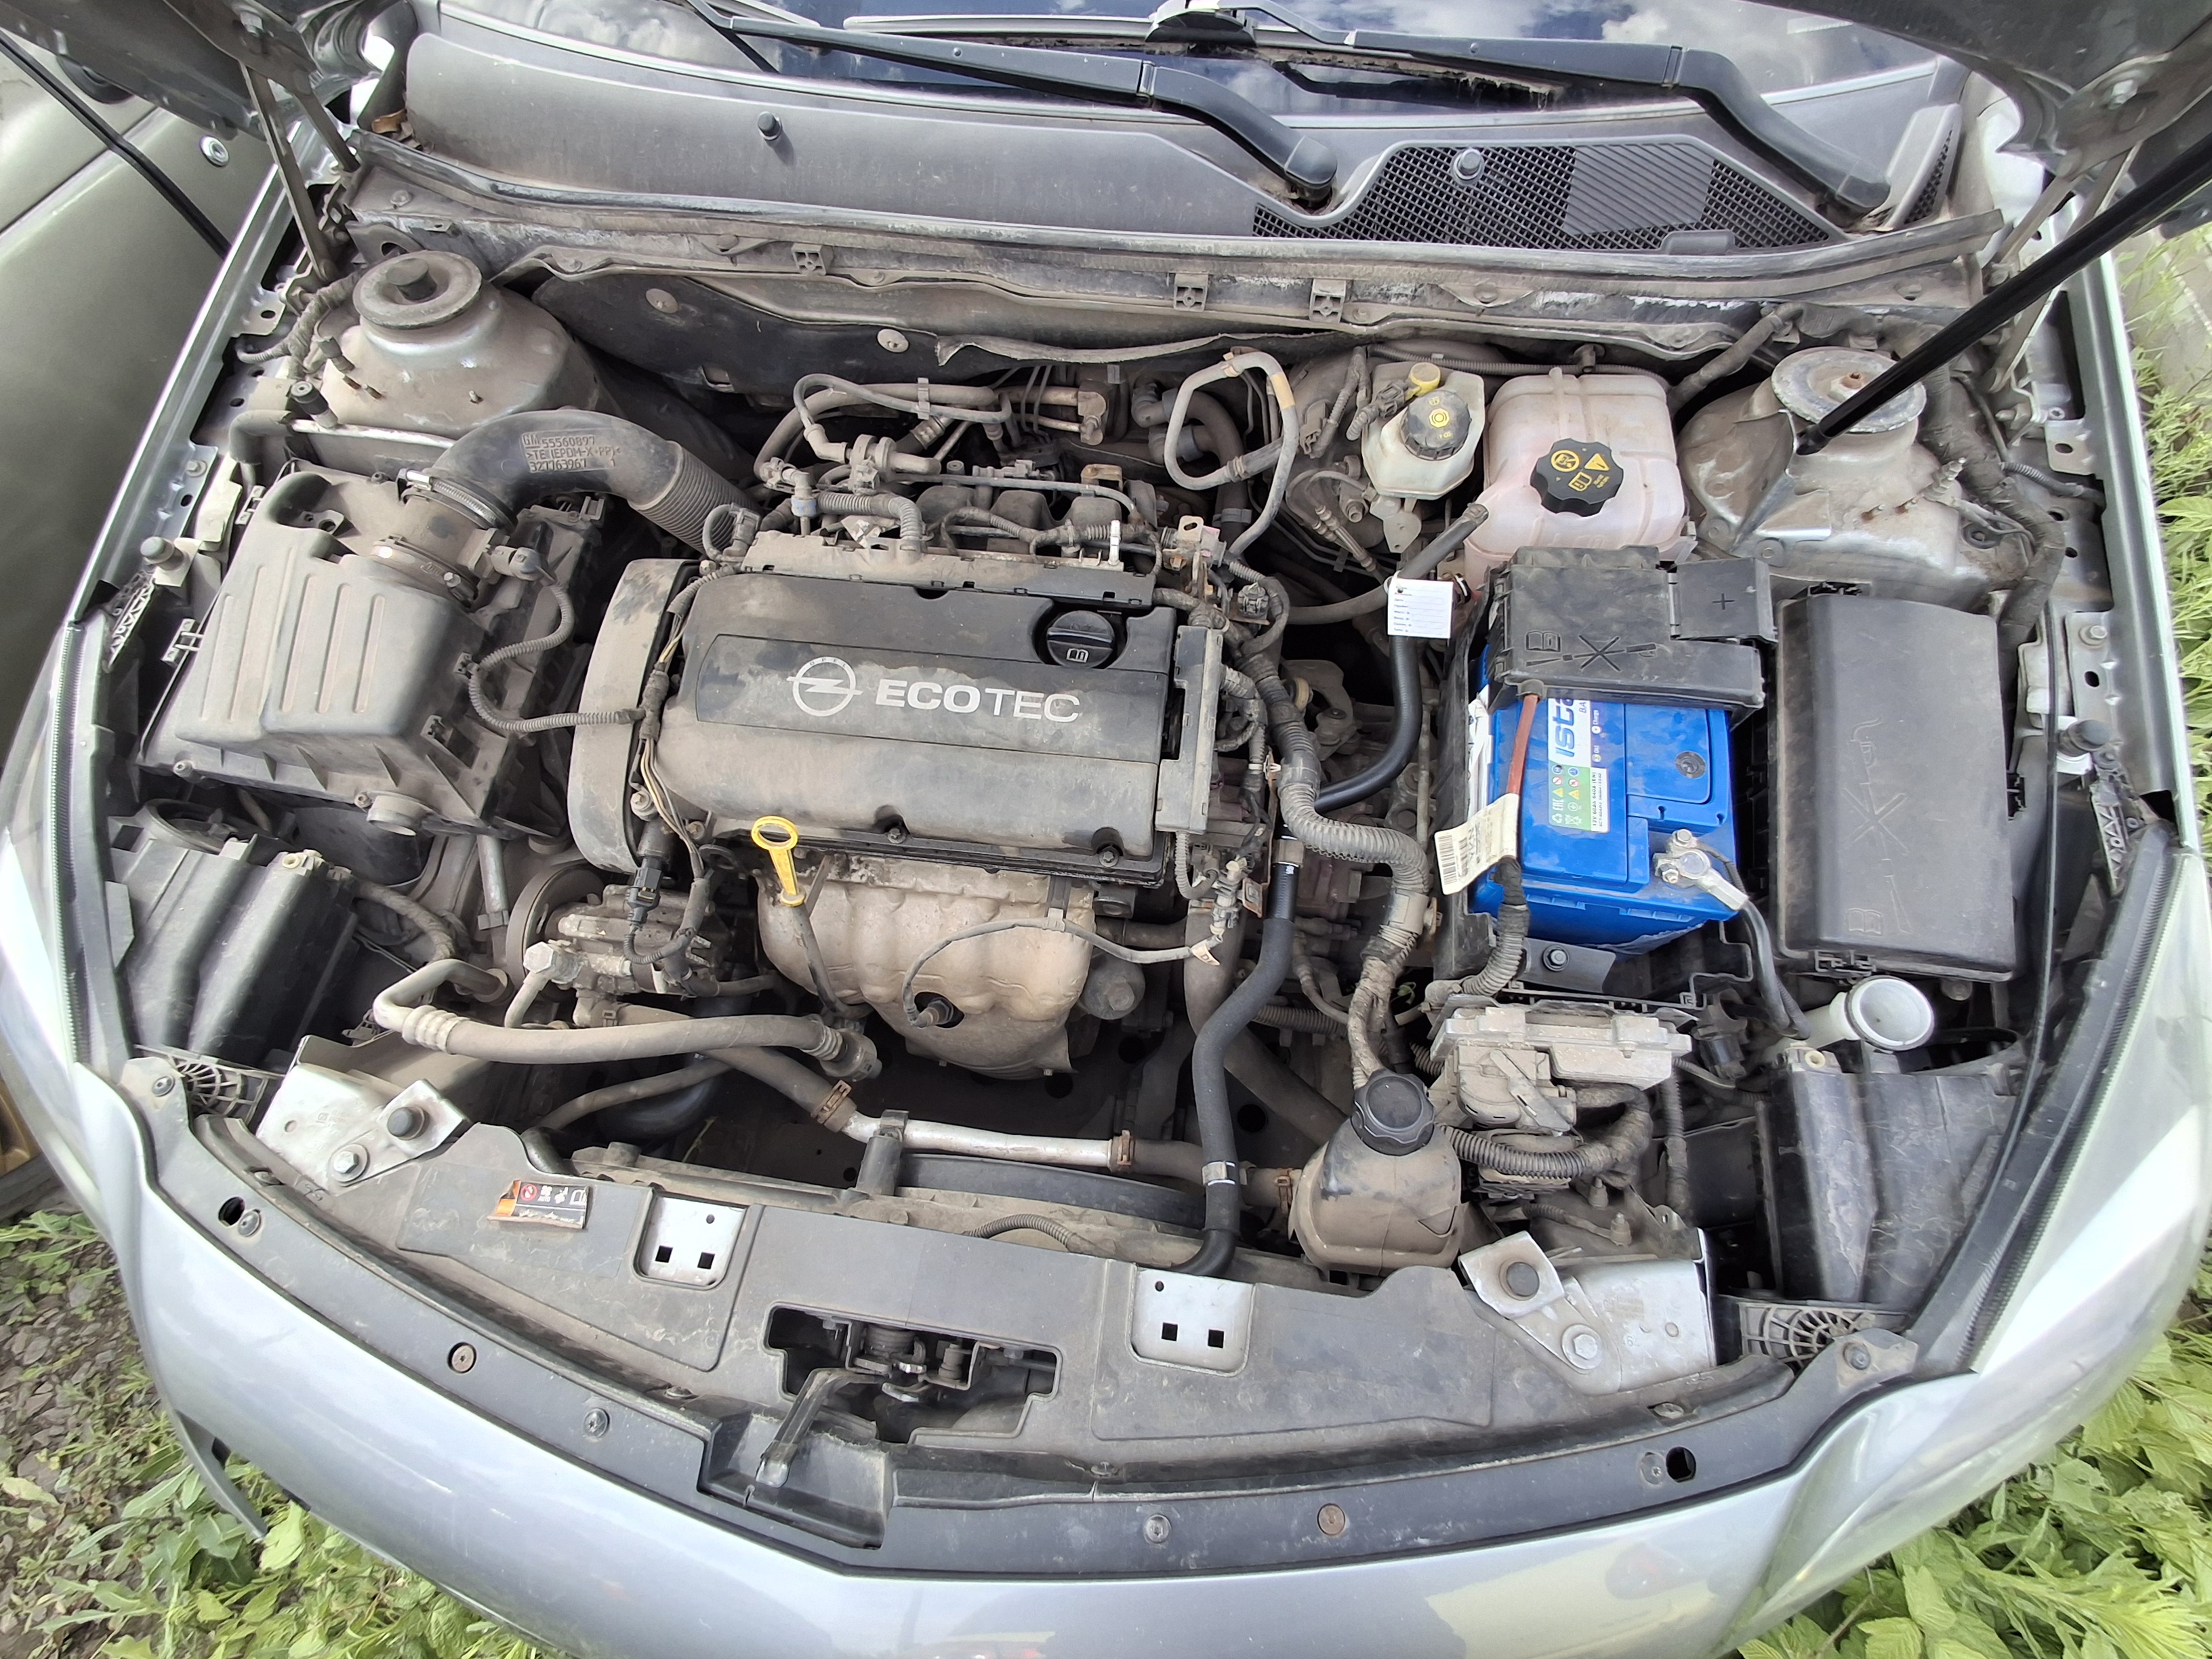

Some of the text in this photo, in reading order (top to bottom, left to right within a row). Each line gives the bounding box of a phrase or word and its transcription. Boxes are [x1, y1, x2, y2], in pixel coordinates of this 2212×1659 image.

[523, 434, 595, 448] GM 55560897
[529, 459, 587, 472] 327763967
[809, 657, 846, 668] OPEL
[875, 678, 1080, 724] ECOTEC
